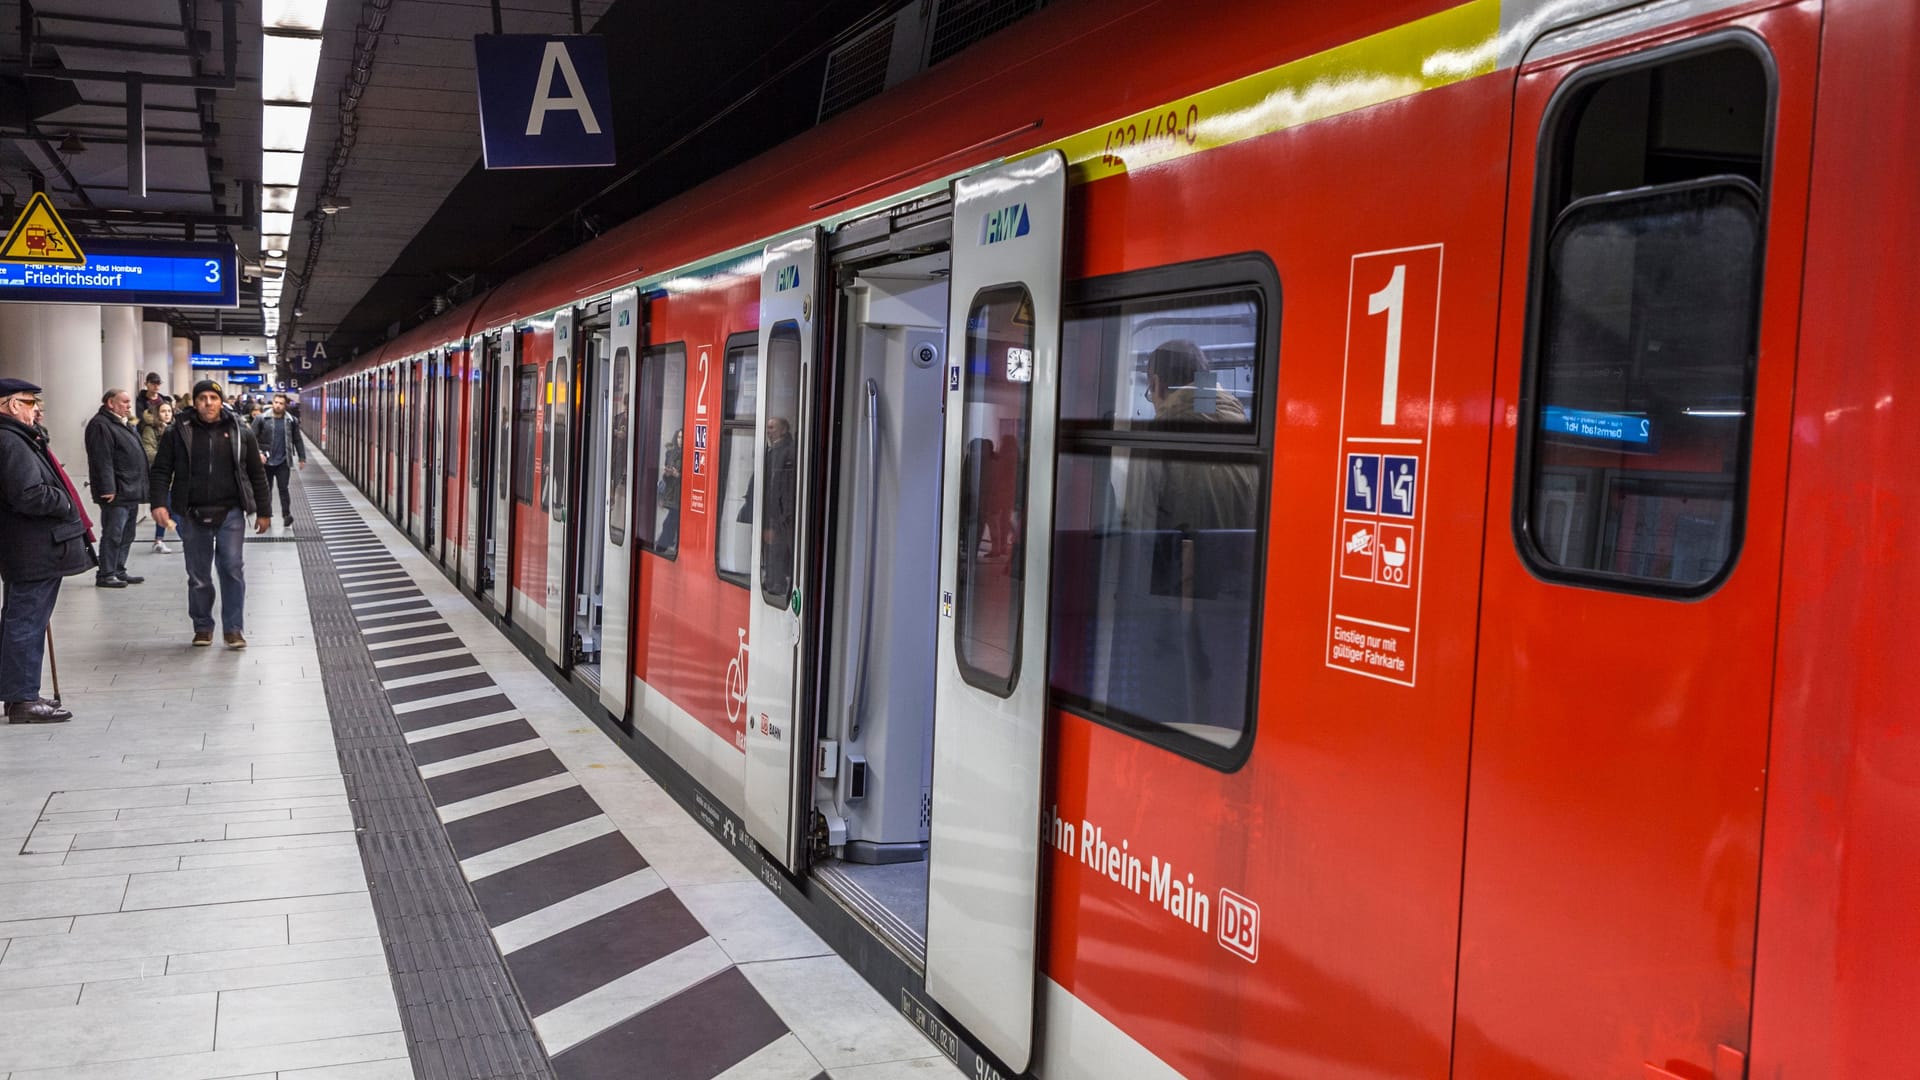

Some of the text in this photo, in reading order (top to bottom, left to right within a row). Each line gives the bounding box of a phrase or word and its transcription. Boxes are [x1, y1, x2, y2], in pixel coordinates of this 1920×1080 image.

[525, 41, 602, 136] A
[25, 271, 122, 287] Friedrichsdorf
[96, 264, 110, 272] Bad
[111, 265, 143, 275] Homburg
[204, 259, 220, 283] 3
[313, 343, 328, 359] A
[1367, 264, 1406, 426] 1
[248, 356, 255, 364] 3
[291, 379, 299, 388] B
[697, 351, 709, 414] 2
[1334, 626, 1396, 652] Einstieg nur mit
[1333, 643, 1405, 671] gültiger Fahrkarte
[769, 723, 782, 741] BAHN
[1080, 819, 1210, 934] Rhein-Main
[1220, 895, 1258, 956] DB
